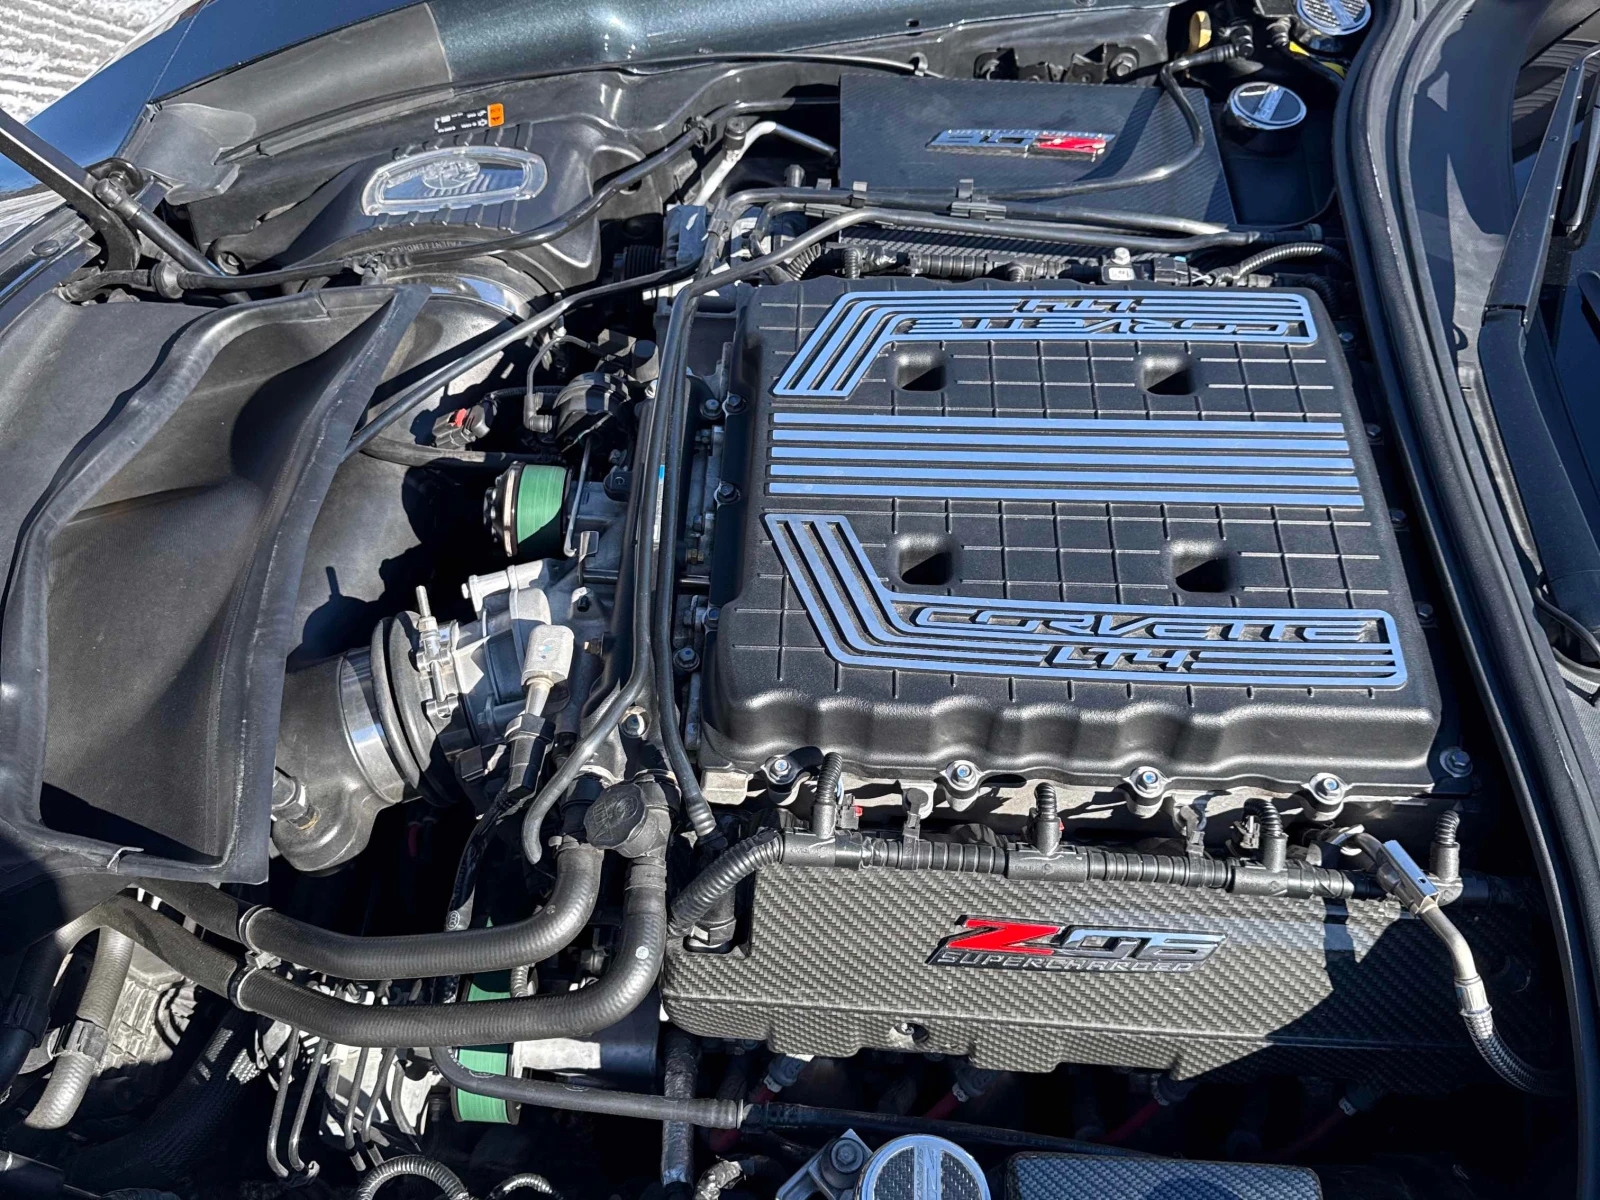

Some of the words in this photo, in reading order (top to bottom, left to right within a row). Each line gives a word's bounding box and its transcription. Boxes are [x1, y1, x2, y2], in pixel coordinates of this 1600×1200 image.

[908, 317, 1291, 336] CORVETTE
[914, 607, 1369, 642] CORVETTE
[1052, 645, 1191, 670] LT4
[942, 914, 1228, 962] Z06
[937, 950, 1195, 973] SUPERCHARGED
